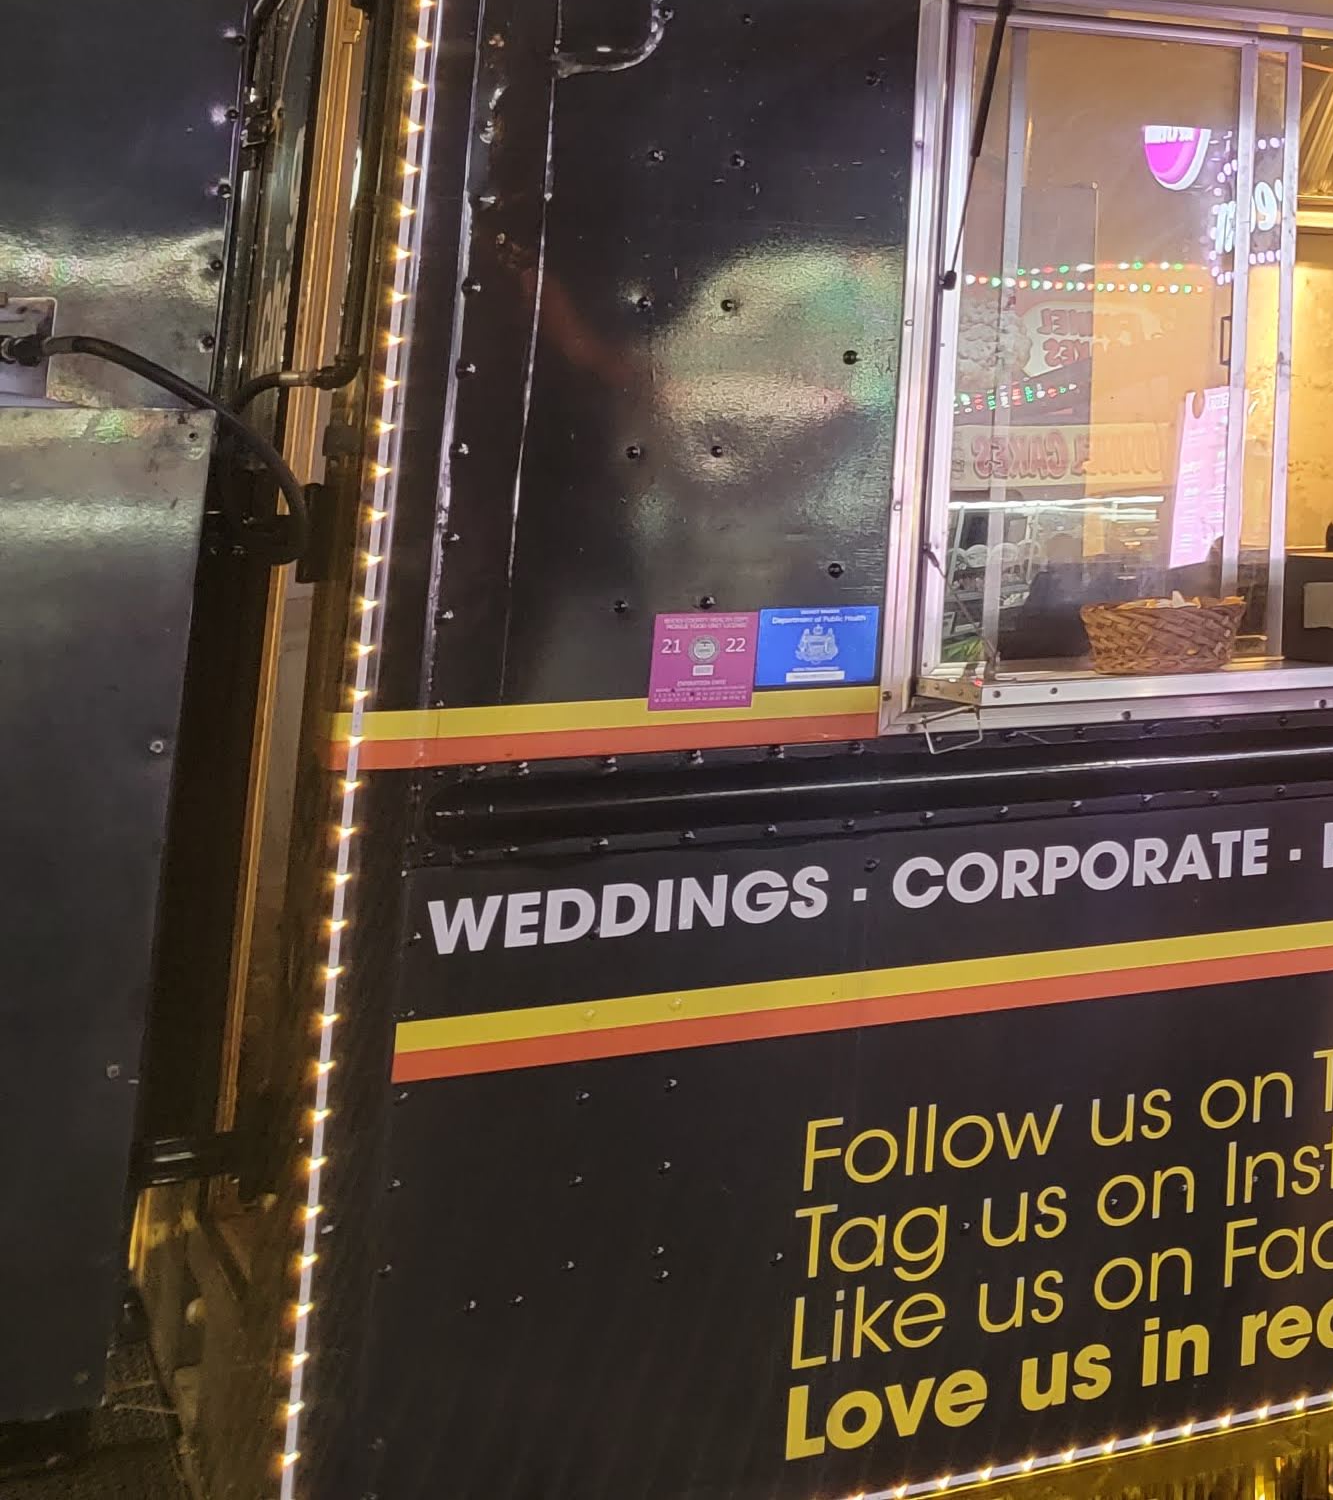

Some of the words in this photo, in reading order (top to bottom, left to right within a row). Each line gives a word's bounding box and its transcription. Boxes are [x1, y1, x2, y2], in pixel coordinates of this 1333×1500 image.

[661, 638, 682, 654] 21
[725, 637, 746, 653] 22
[428, 865, 829, 955] WEDDINGS
[891, 827, 1269, 910] CORPORATE
[801, 1102, 1064, 1193] Follow
[1089, 1087, 1172, 1149] us
[1199, 1069, 1295, 1132] on
[795, 1202, 948, 1283] Tag
[979, 1185, 1068, 1249] us
[1095, 1164, 1196, 1228] on
[790, 1284, 946, 1371] Like
[977, 1270, 1064, 1334] us
[1093, 1246, 1193, 1311] on
[784, 1368, 989, 1461] Love
[1020, 1342, 1112, 1412] us
[1141, 1314, 1210, 1387] in
